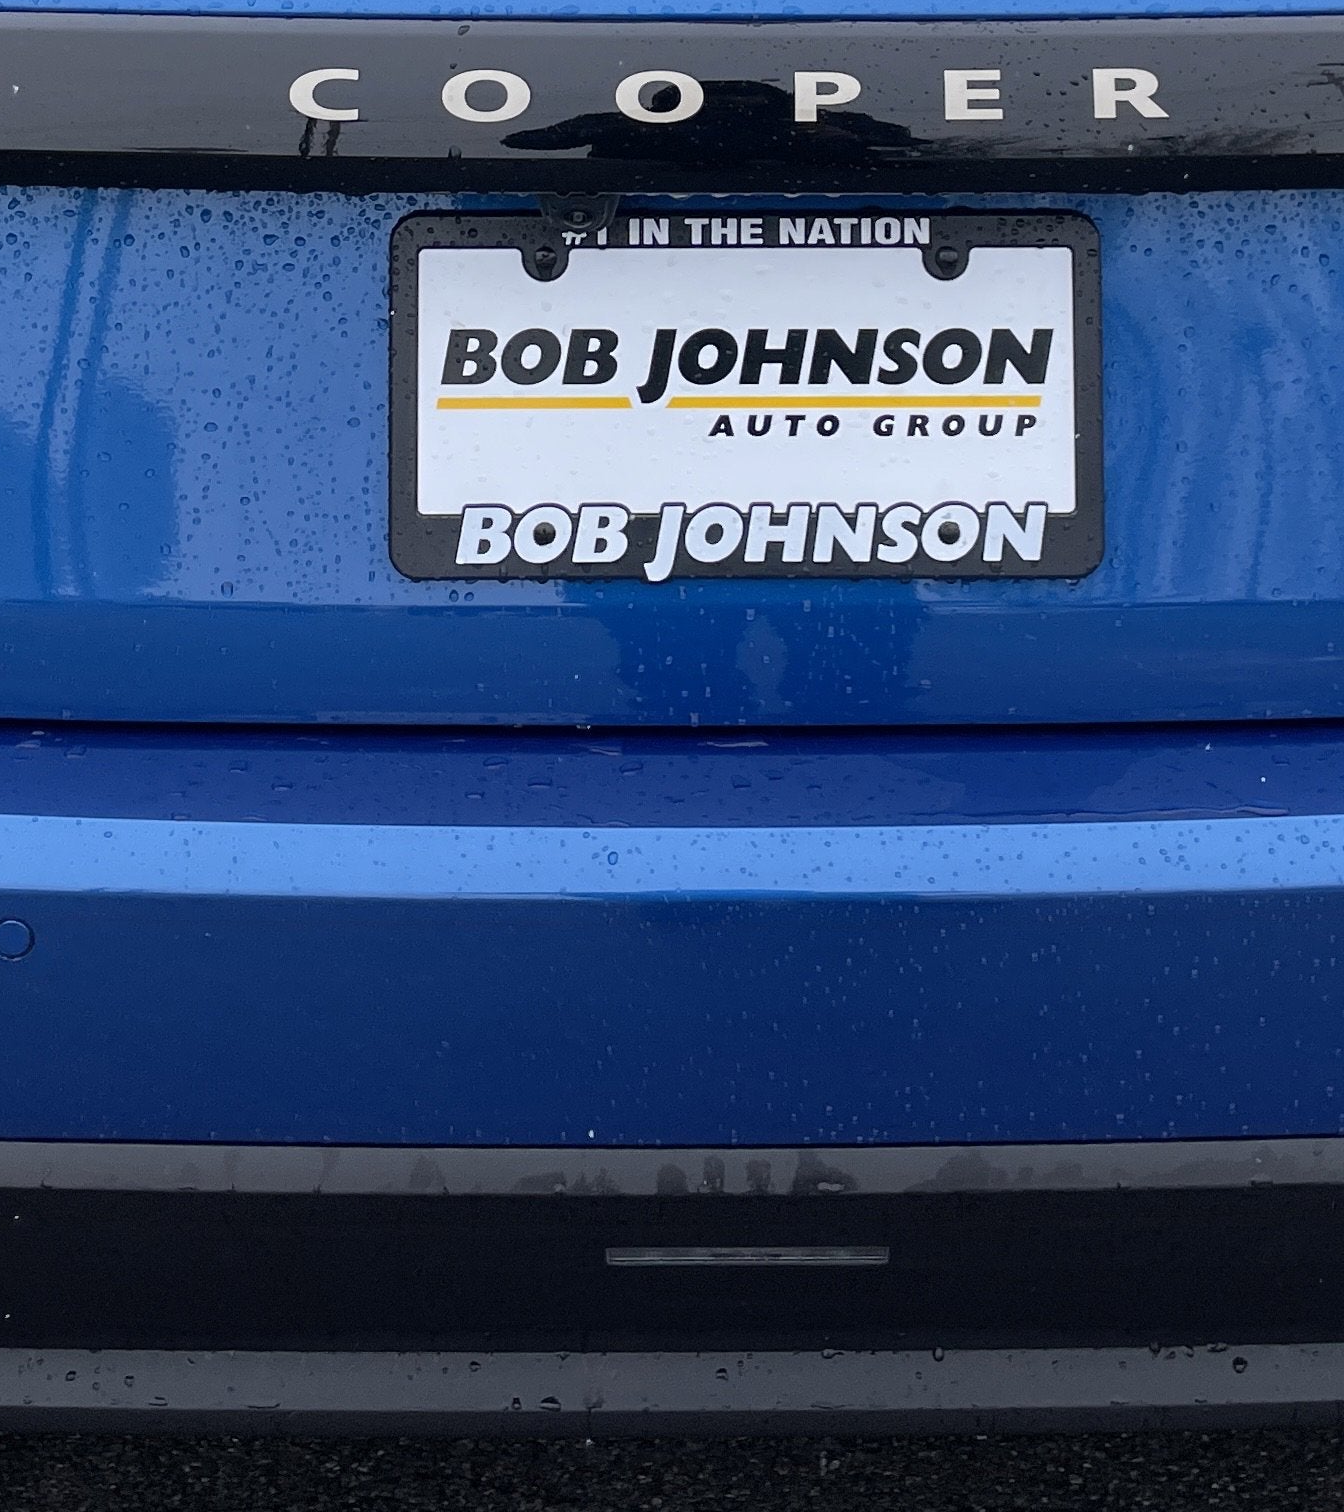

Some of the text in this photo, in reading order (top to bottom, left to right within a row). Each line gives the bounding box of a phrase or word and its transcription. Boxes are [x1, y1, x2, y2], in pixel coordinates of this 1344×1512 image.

[289, 68, 1170, 123] COOPER
[629, 218, 669, 245] IN
[684, 218, 764, 245] THE
[779, 217, 930, 245] NATION
[440, 328, 1054, 404] BOB JOHNSON
[709, 414, 1037, 437] AUTO GROUP
[455, 503, 1048, 583] BOB JOHNSON
